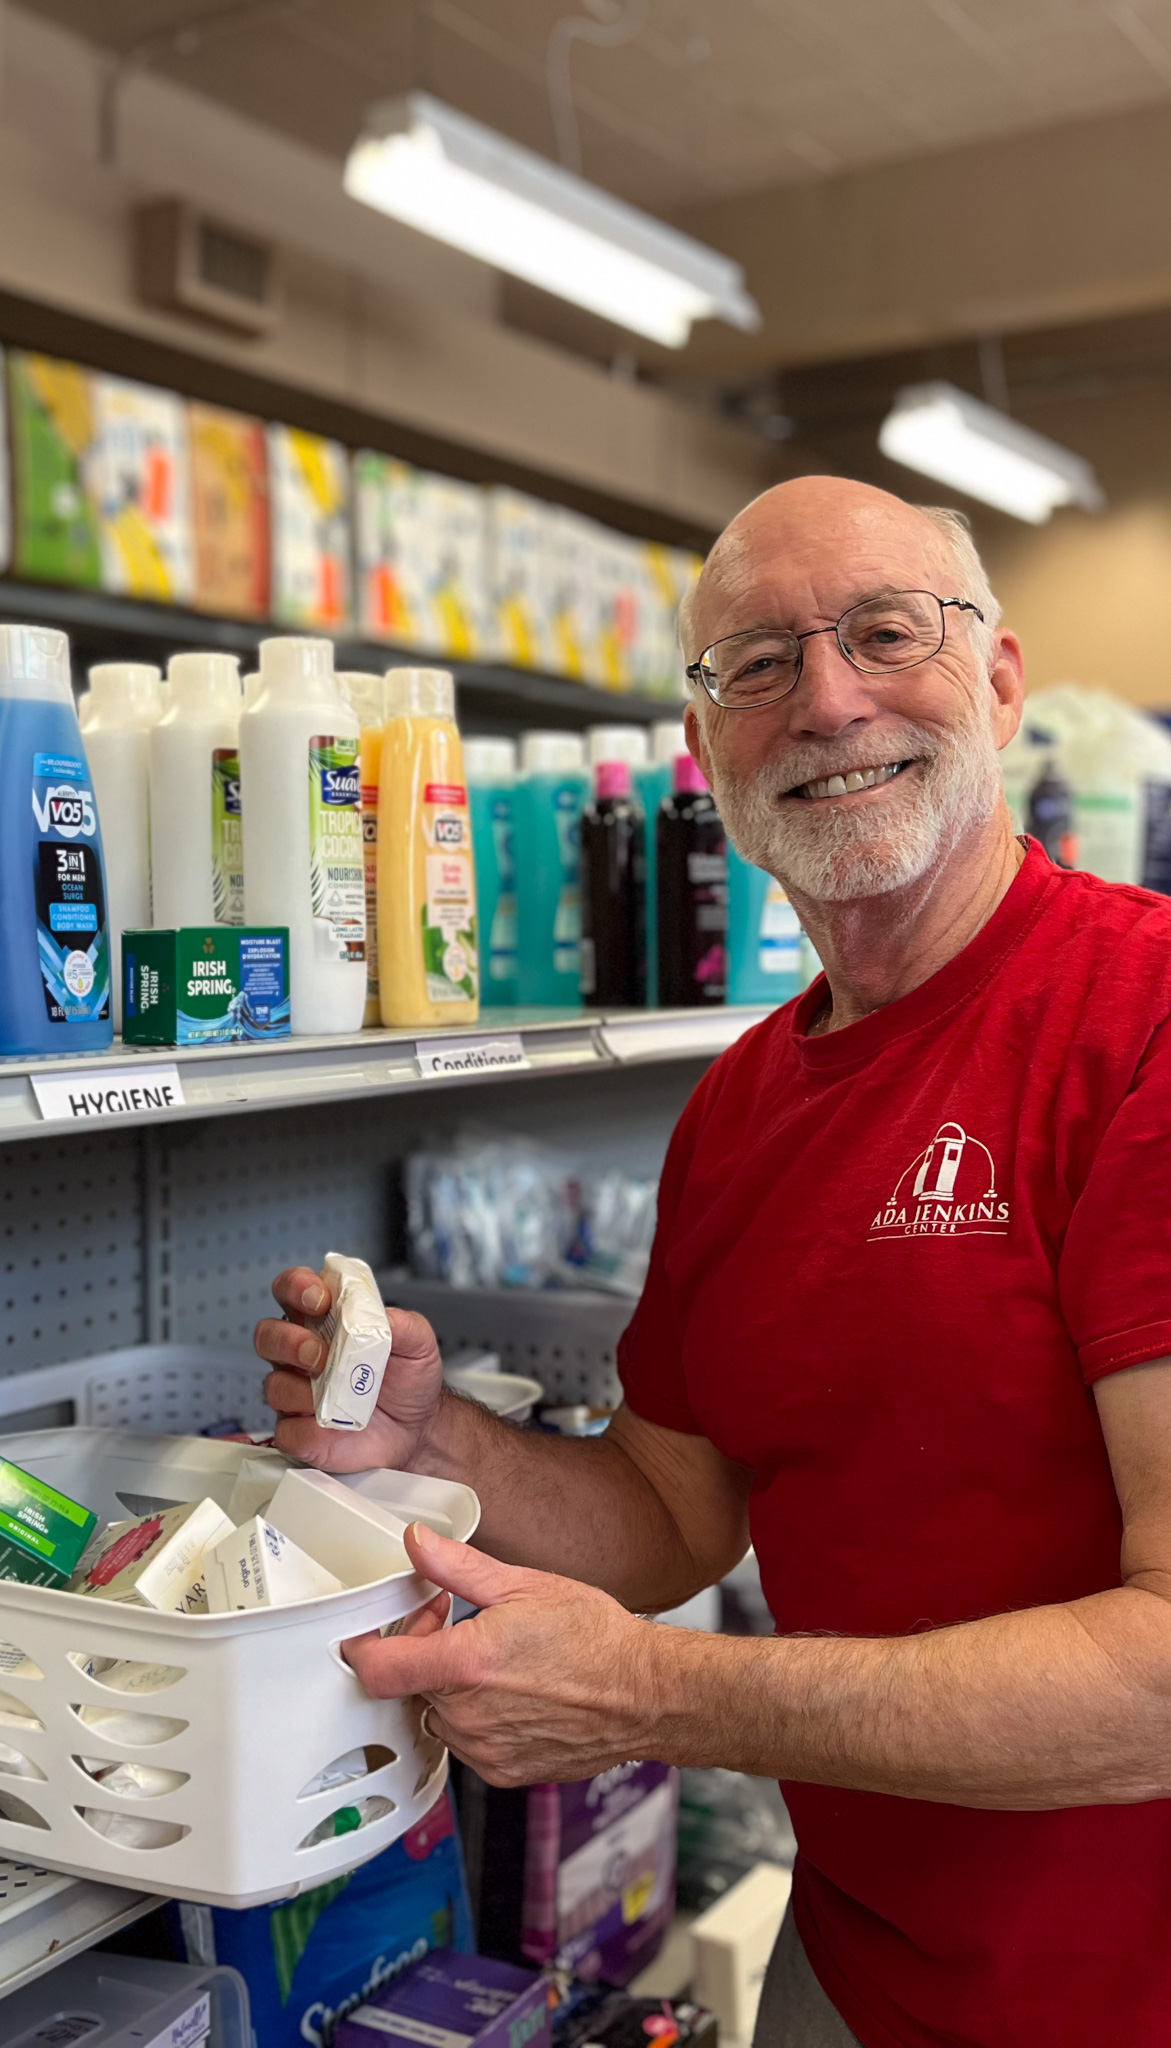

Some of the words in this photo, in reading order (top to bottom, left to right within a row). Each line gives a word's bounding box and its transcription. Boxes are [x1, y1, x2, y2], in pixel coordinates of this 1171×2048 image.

[50, 801, 82, 823] VO5
[320, 810, 362, 834] TROPIC
[58, 873, 71, 881] FOR
[72, 874, 86, 882] MEN
[61, 883, 83, 891] OCEAN
[63, 892, 83, 900] SURGE
[76, 922, 93, 930] WASH
[193, 960, 226, 977] IRISH
[140, 965, 149, 1010] SPRING
[150, 971, 159, 1004] IRISH
[187, 978, 232, 996] SPRING
[68, 1086, 175, 1117] HYGIENE
[871, 1208, 906, 1227] ADA
[914, 1202, 1010, 1224] JENKINS
[904, 1224, 956, 1234] CENTER
[354, 1368, 370, 1391] Dial
[17, 1511, 46, 1532] SPRING
[24, 1506, 46, 1522] IRISH
[9, 1522, 39, 1544] ORIGINAL
[238, 1557, 251, 1589] original
